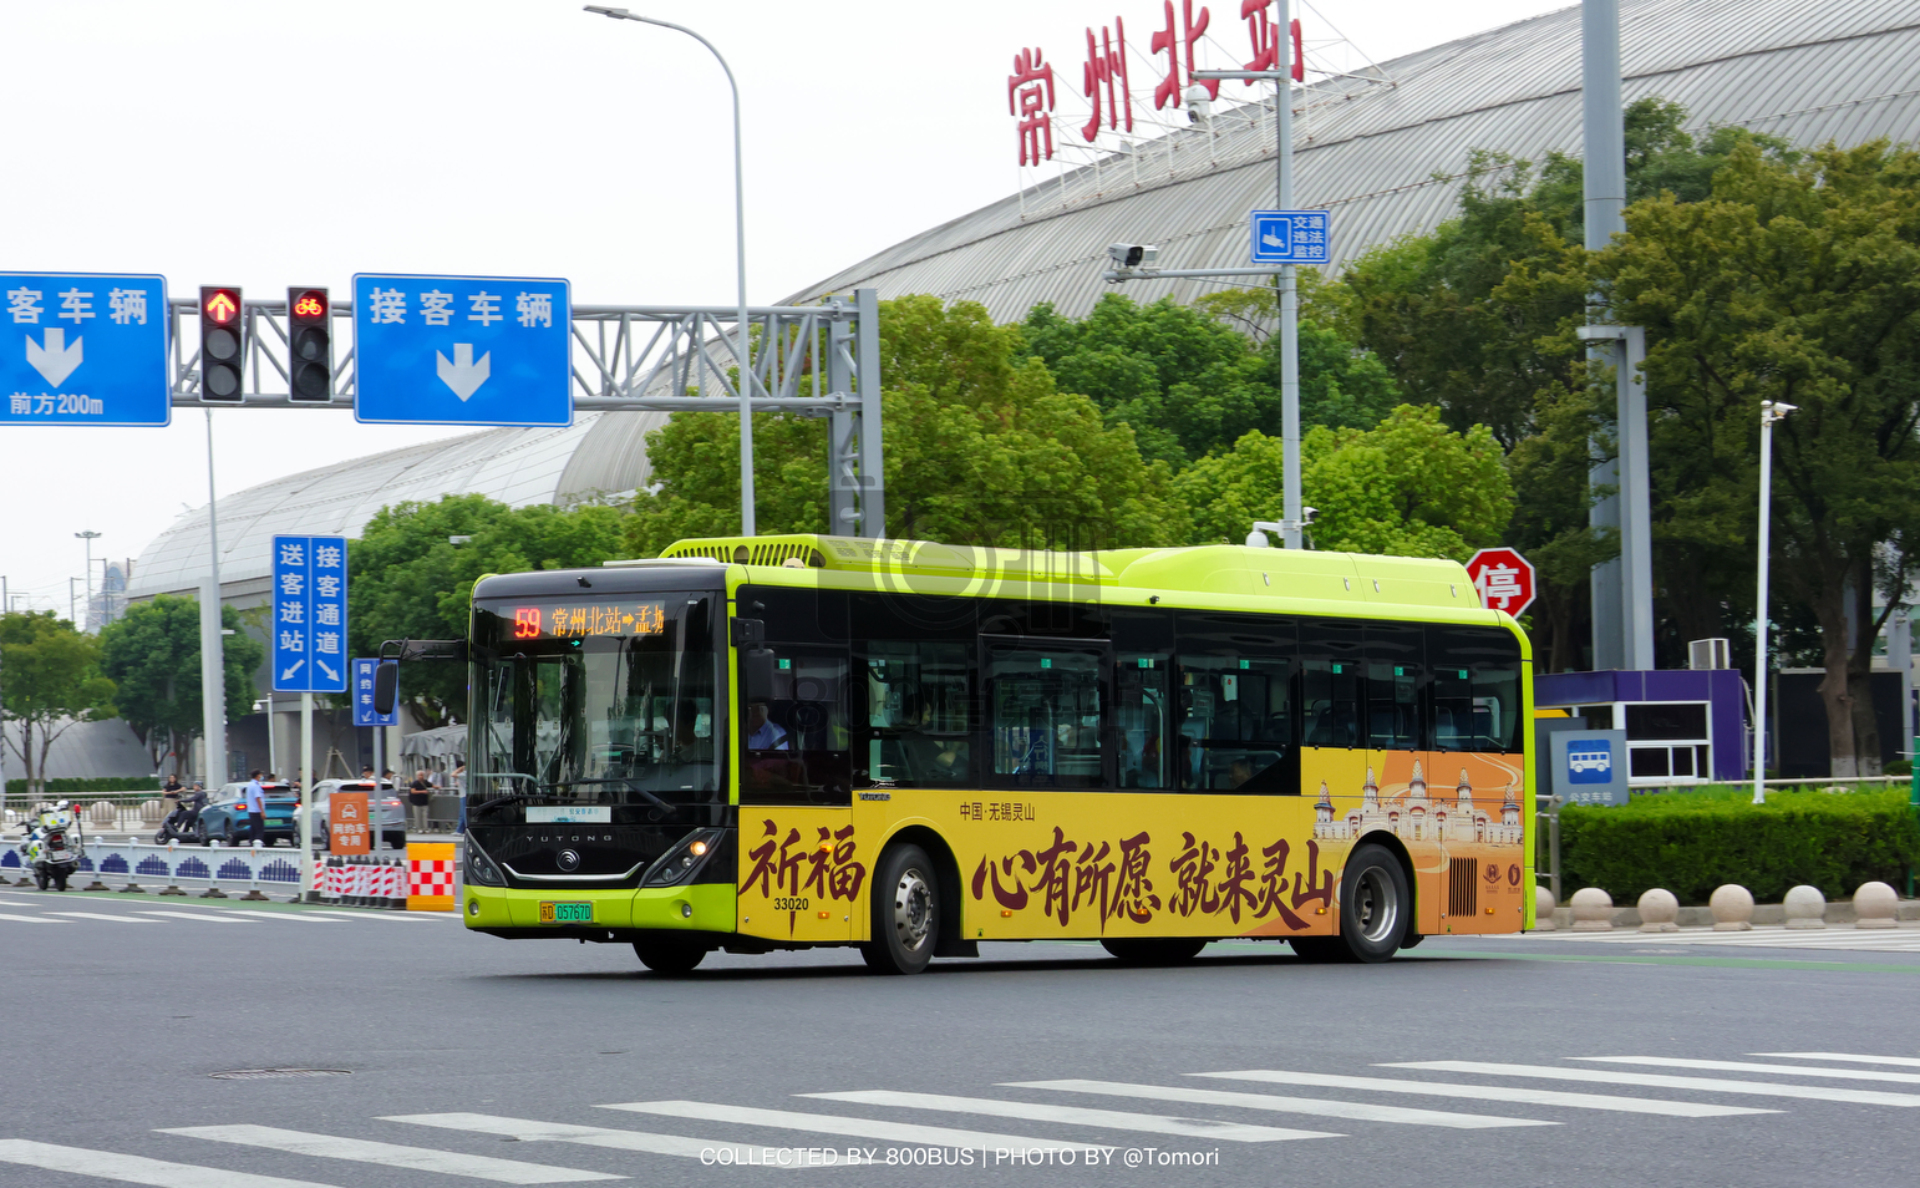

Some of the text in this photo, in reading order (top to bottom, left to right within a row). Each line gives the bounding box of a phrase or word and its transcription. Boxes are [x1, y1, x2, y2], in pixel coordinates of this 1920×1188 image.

[1293, 216, 1324, 229] 交通
[1293, 230, 1324, 244] 违法
[6, 286, 148, 326] 客车辆
[369, 286, 553, 329] 接客车辆
[9, 391, 104, 416] 前方200m
[280, 543, 305, 653] 送客进站
[316, 545, 341, 655] 接客通道
[1474, 562, 1522, 610] 停
[515, 607, 542, 638] 59
[333, 822, 367, 835] 网约车
[526, 835, 612, 843] YUTONG
[738, 818, 866, 938] 祈福
[971, 825, 1334, 937] 心有所愿 就来灵山
[774, 897, 809, 911] 33020
